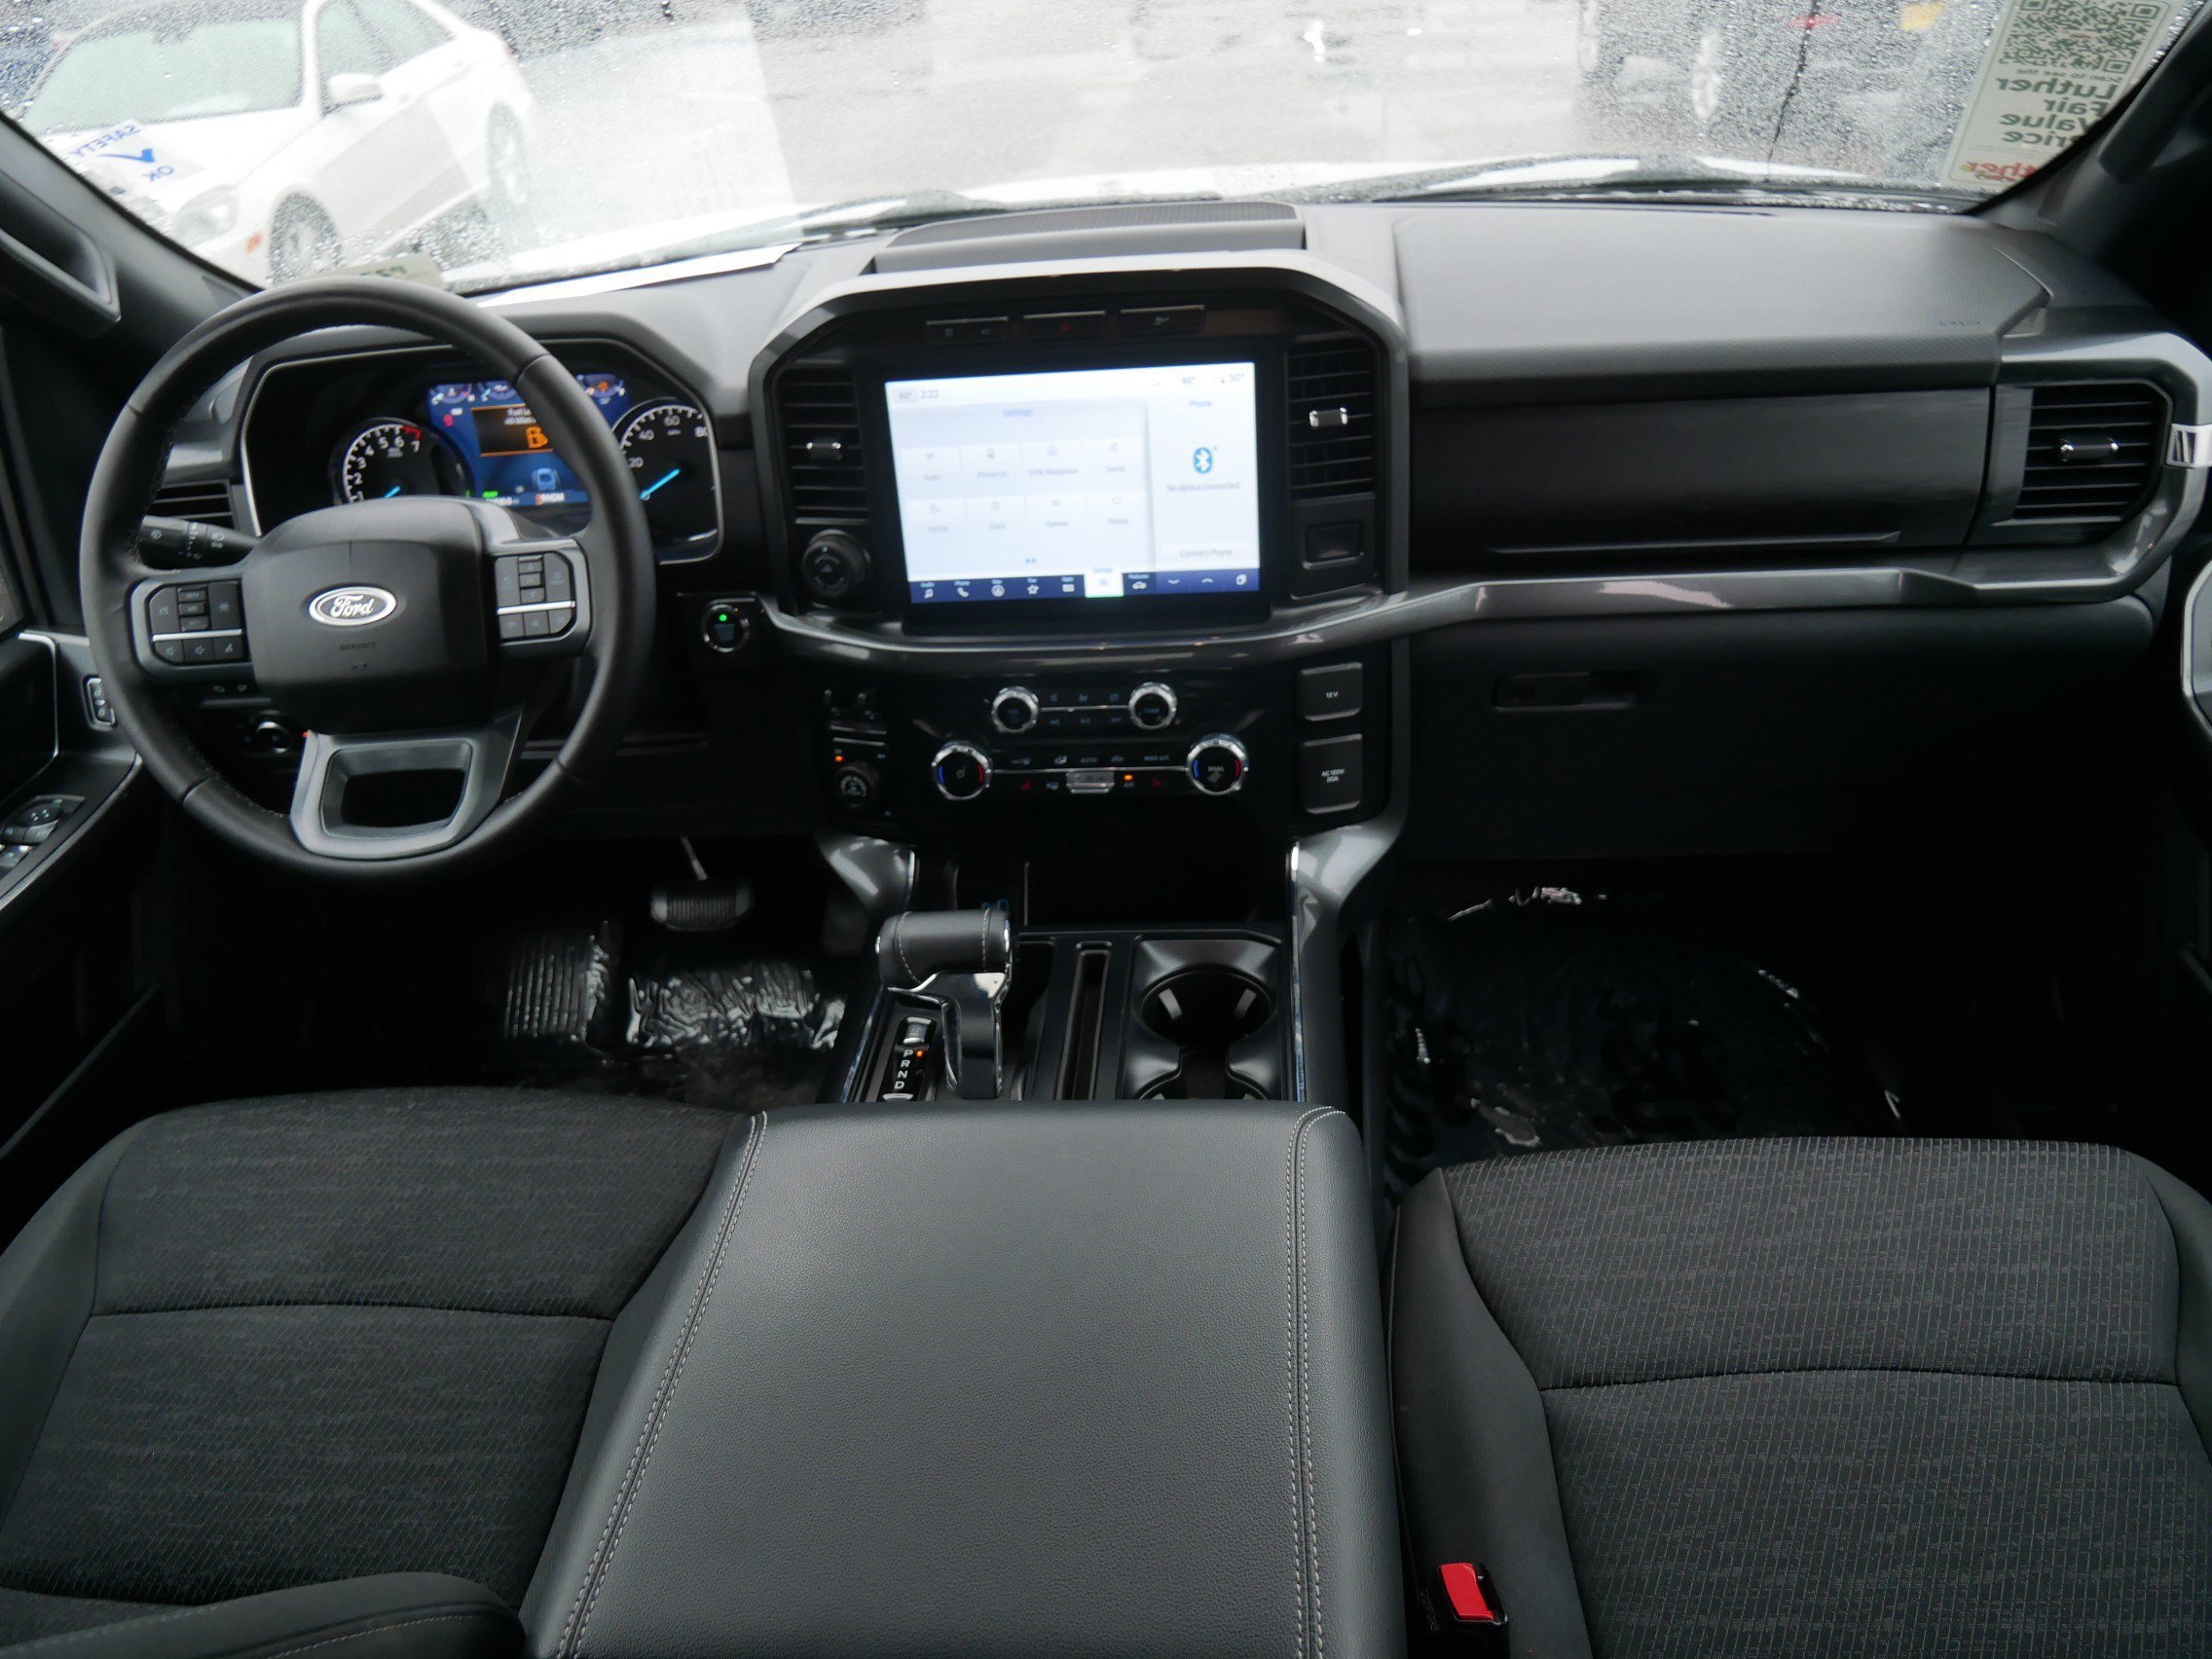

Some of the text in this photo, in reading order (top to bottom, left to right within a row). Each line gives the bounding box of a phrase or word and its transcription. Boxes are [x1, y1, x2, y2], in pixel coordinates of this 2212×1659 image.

[920, 389, 940, 399] 2:22
[663, 415, 681, 426] 60
[638, 428, 654, 440] 40
[378, 436, 388, 449] 5
[394, 436, 405, 448] 6
[411, 440, 420, 453] 7
[365, 444, 375, 457] 4
[356, 457, 367, 469] 3
[628, 457, 644, 468] 20
[353, 472, 363, 485] 2
[330, 595, 375, 617] Ford
[903, 1049, 913, 1057] P
[897, 1070, 908, 1079] N
[894, 1081, 905, 1089] D
